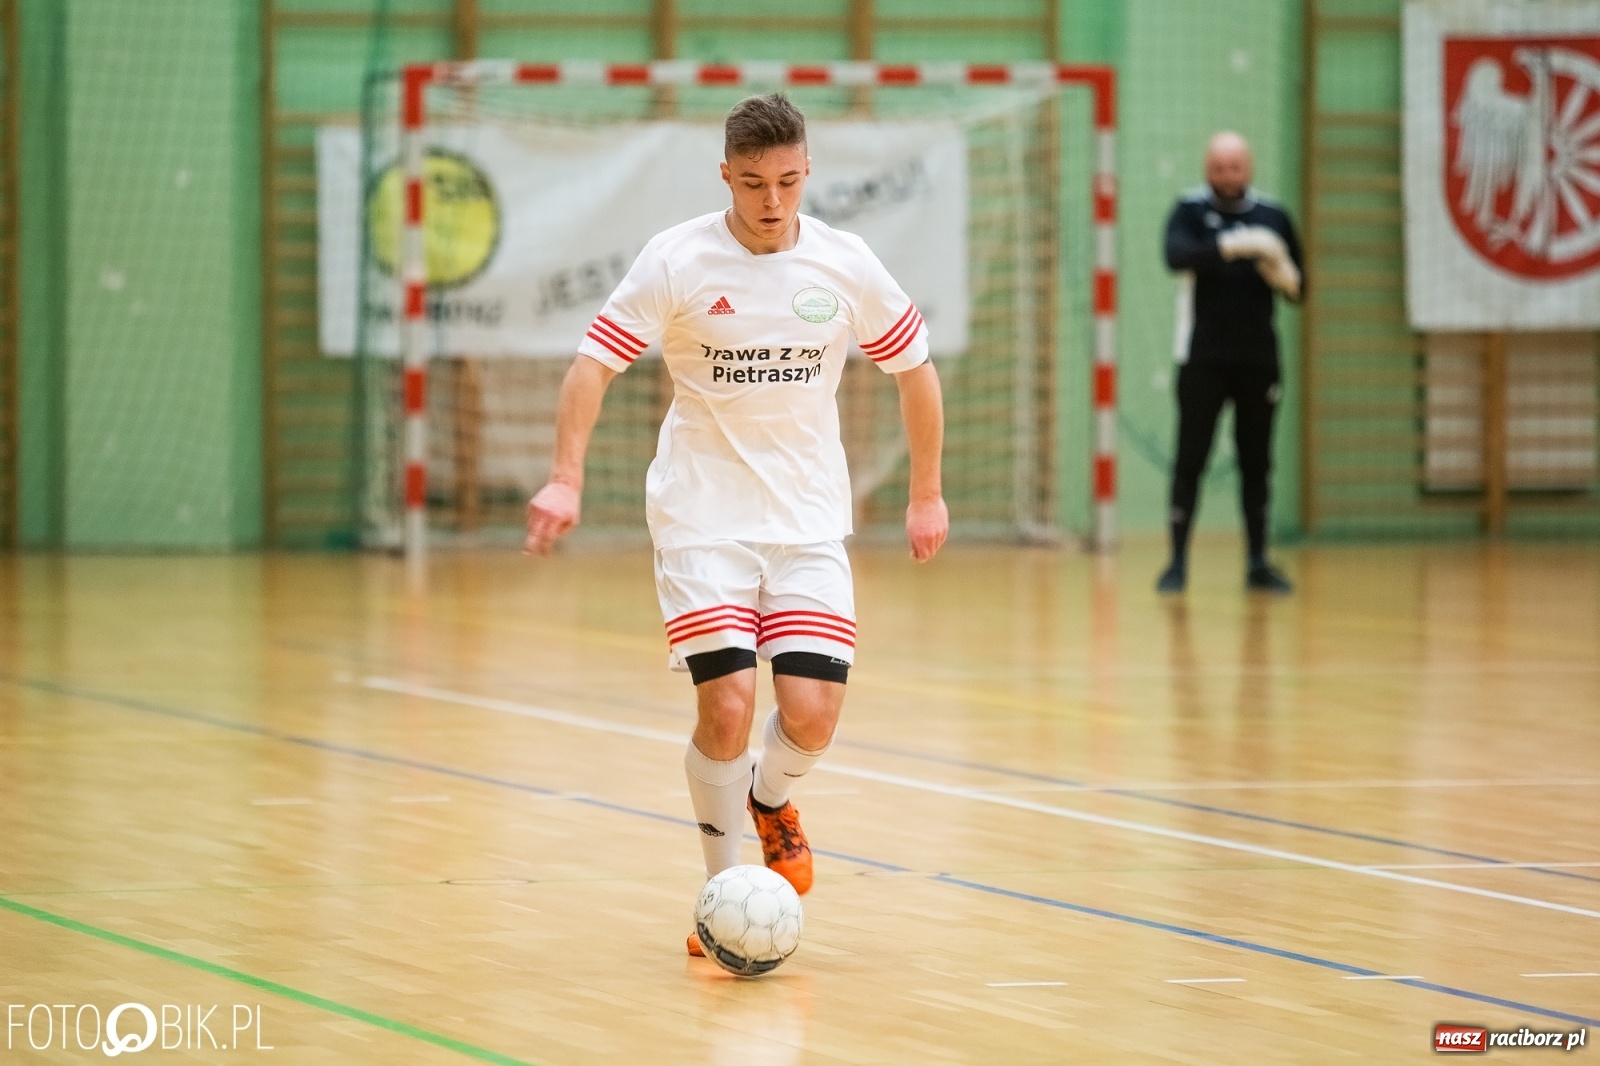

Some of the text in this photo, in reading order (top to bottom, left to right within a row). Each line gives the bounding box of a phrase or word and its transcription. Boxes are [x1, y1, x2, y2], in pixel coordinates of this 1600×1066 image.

[707, 308, 736, 316] adidas
[701, 344, 829, 361] Trawa z rol
[713, 362, 822, 384] Pietraszyn
